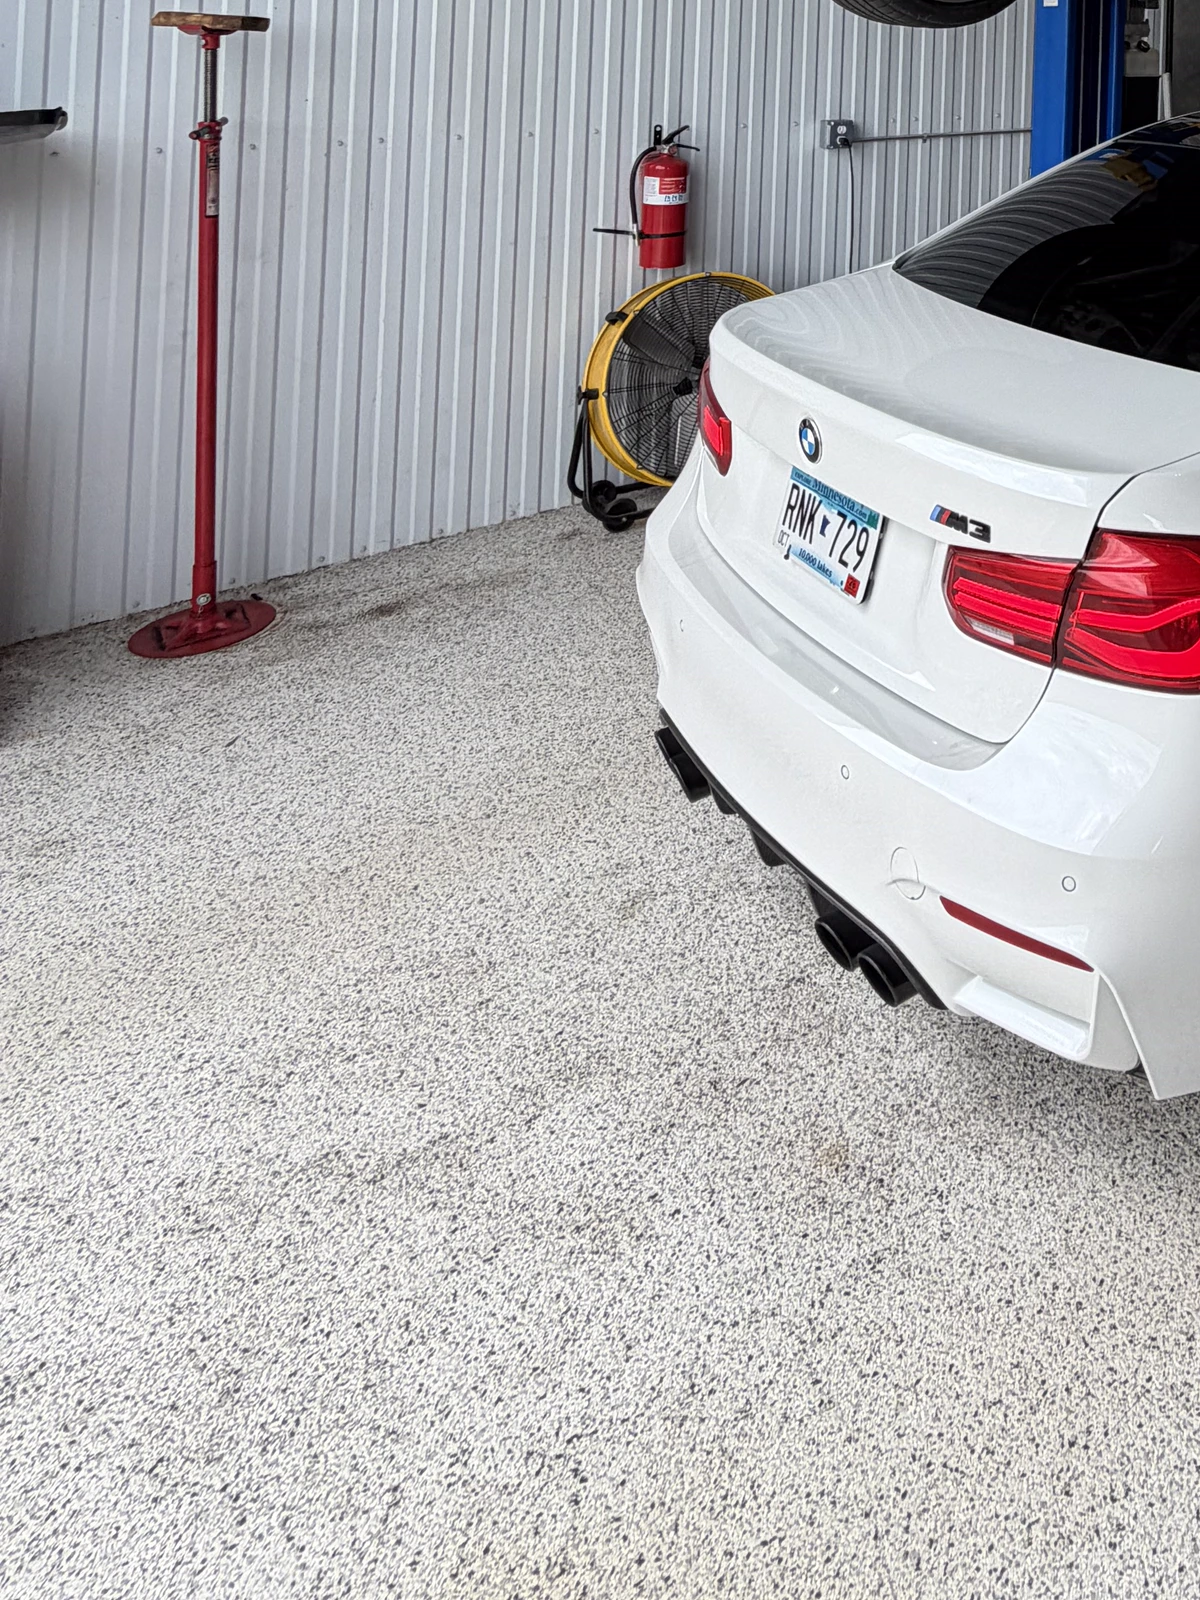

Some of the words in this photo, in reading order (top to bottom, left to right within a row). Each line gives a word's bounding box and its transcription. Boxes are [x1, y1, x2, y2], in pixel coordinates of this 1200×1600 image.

[811, 478, 868, 519] Minnesota.com
[777, 529, 790, 547] OCT
[782, 482, 823, 545] RNK
[828, 509, 870, 573] 729
[936, 505, 991, 544] M3
[798, 548, 817, 567] 10,000
